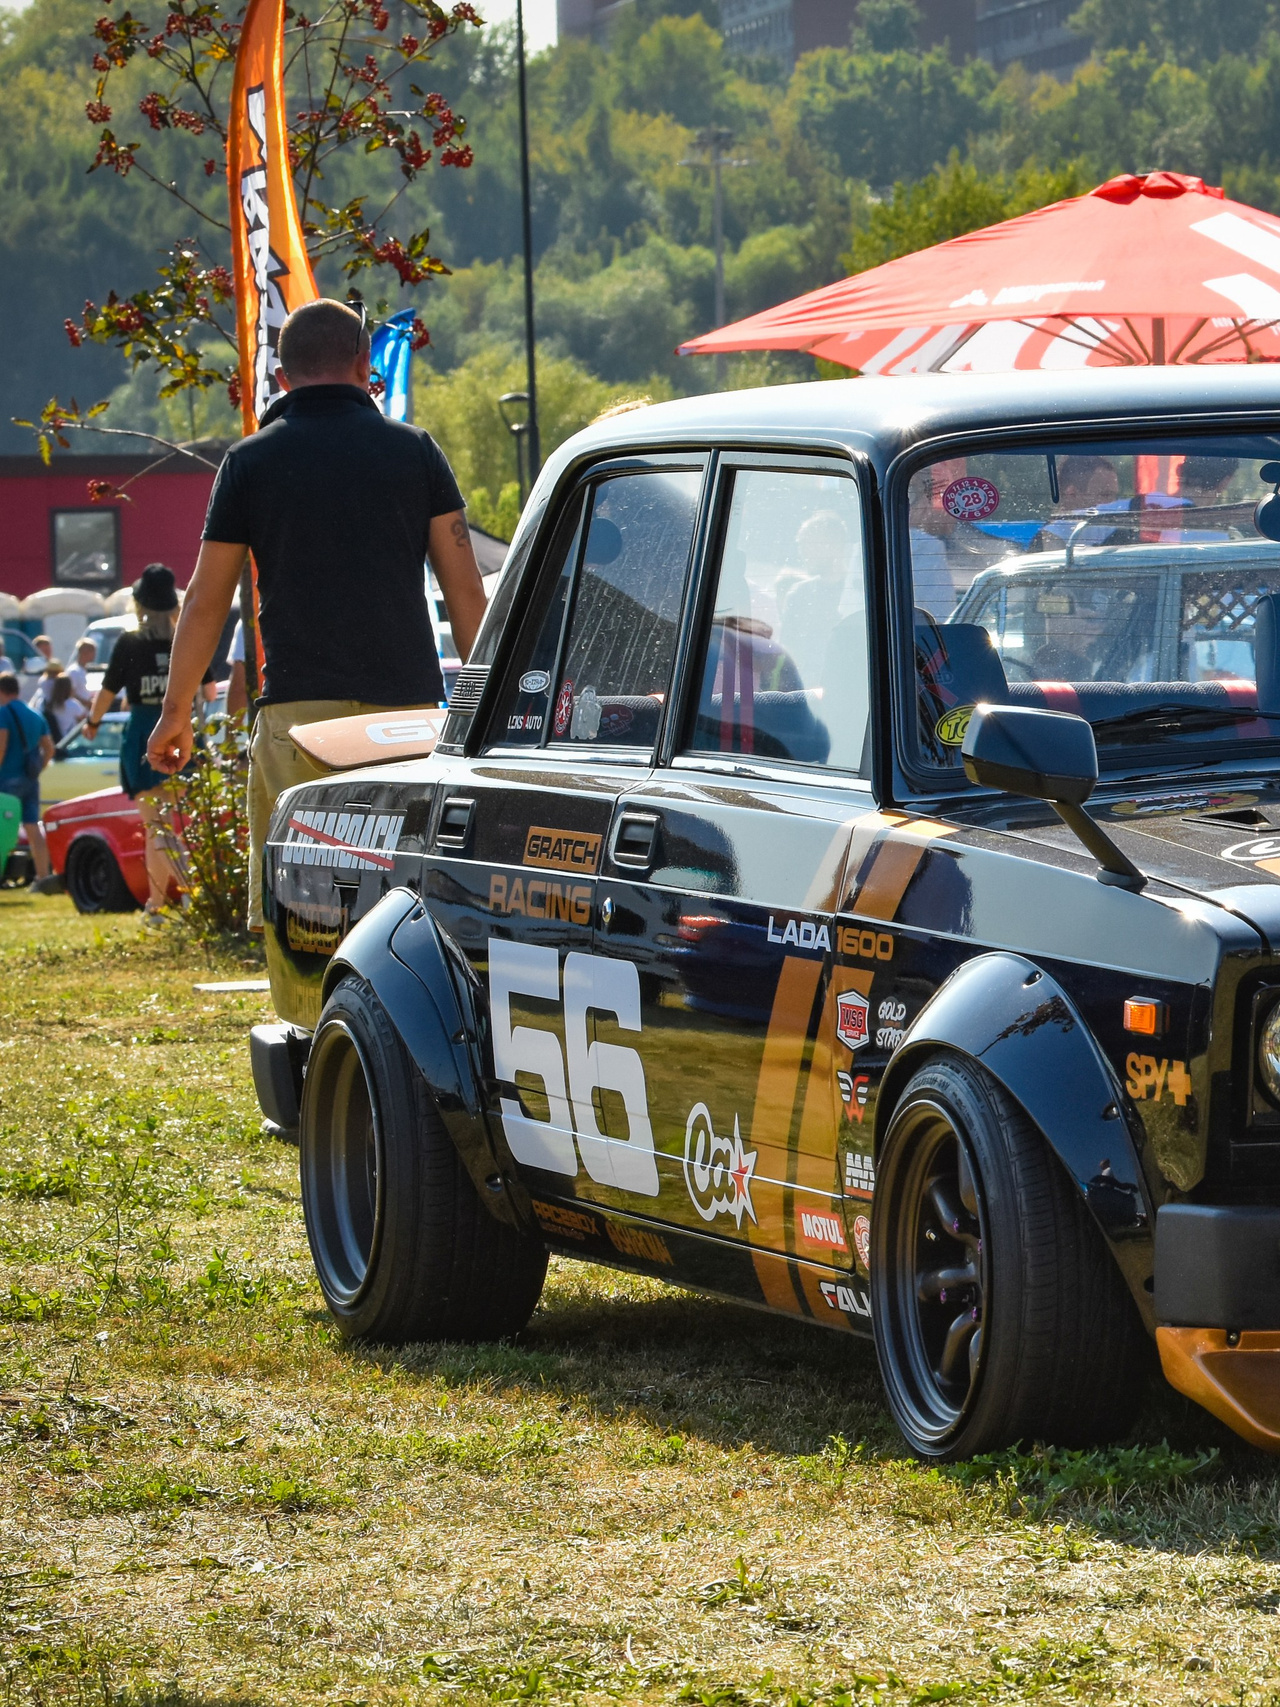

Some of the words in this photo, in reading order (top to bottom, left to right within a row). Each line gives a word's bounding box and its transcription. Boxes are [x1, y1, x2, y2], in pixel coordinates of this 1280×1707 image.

[962, 492, 982, 508] 28
[527, 835, 599, 866] GRATCH
[488, 873, 593, 926] RACING
[767, 915, 832, 953] LADA
[836, 925, 895, 961] 1600
[842, 1006, 864, 1029] WSG
[878, 1001, 907, 1022] GOLD
[488, 937, 660, 1197] 56
[801, 1212, 845, 1246] MOTUL
